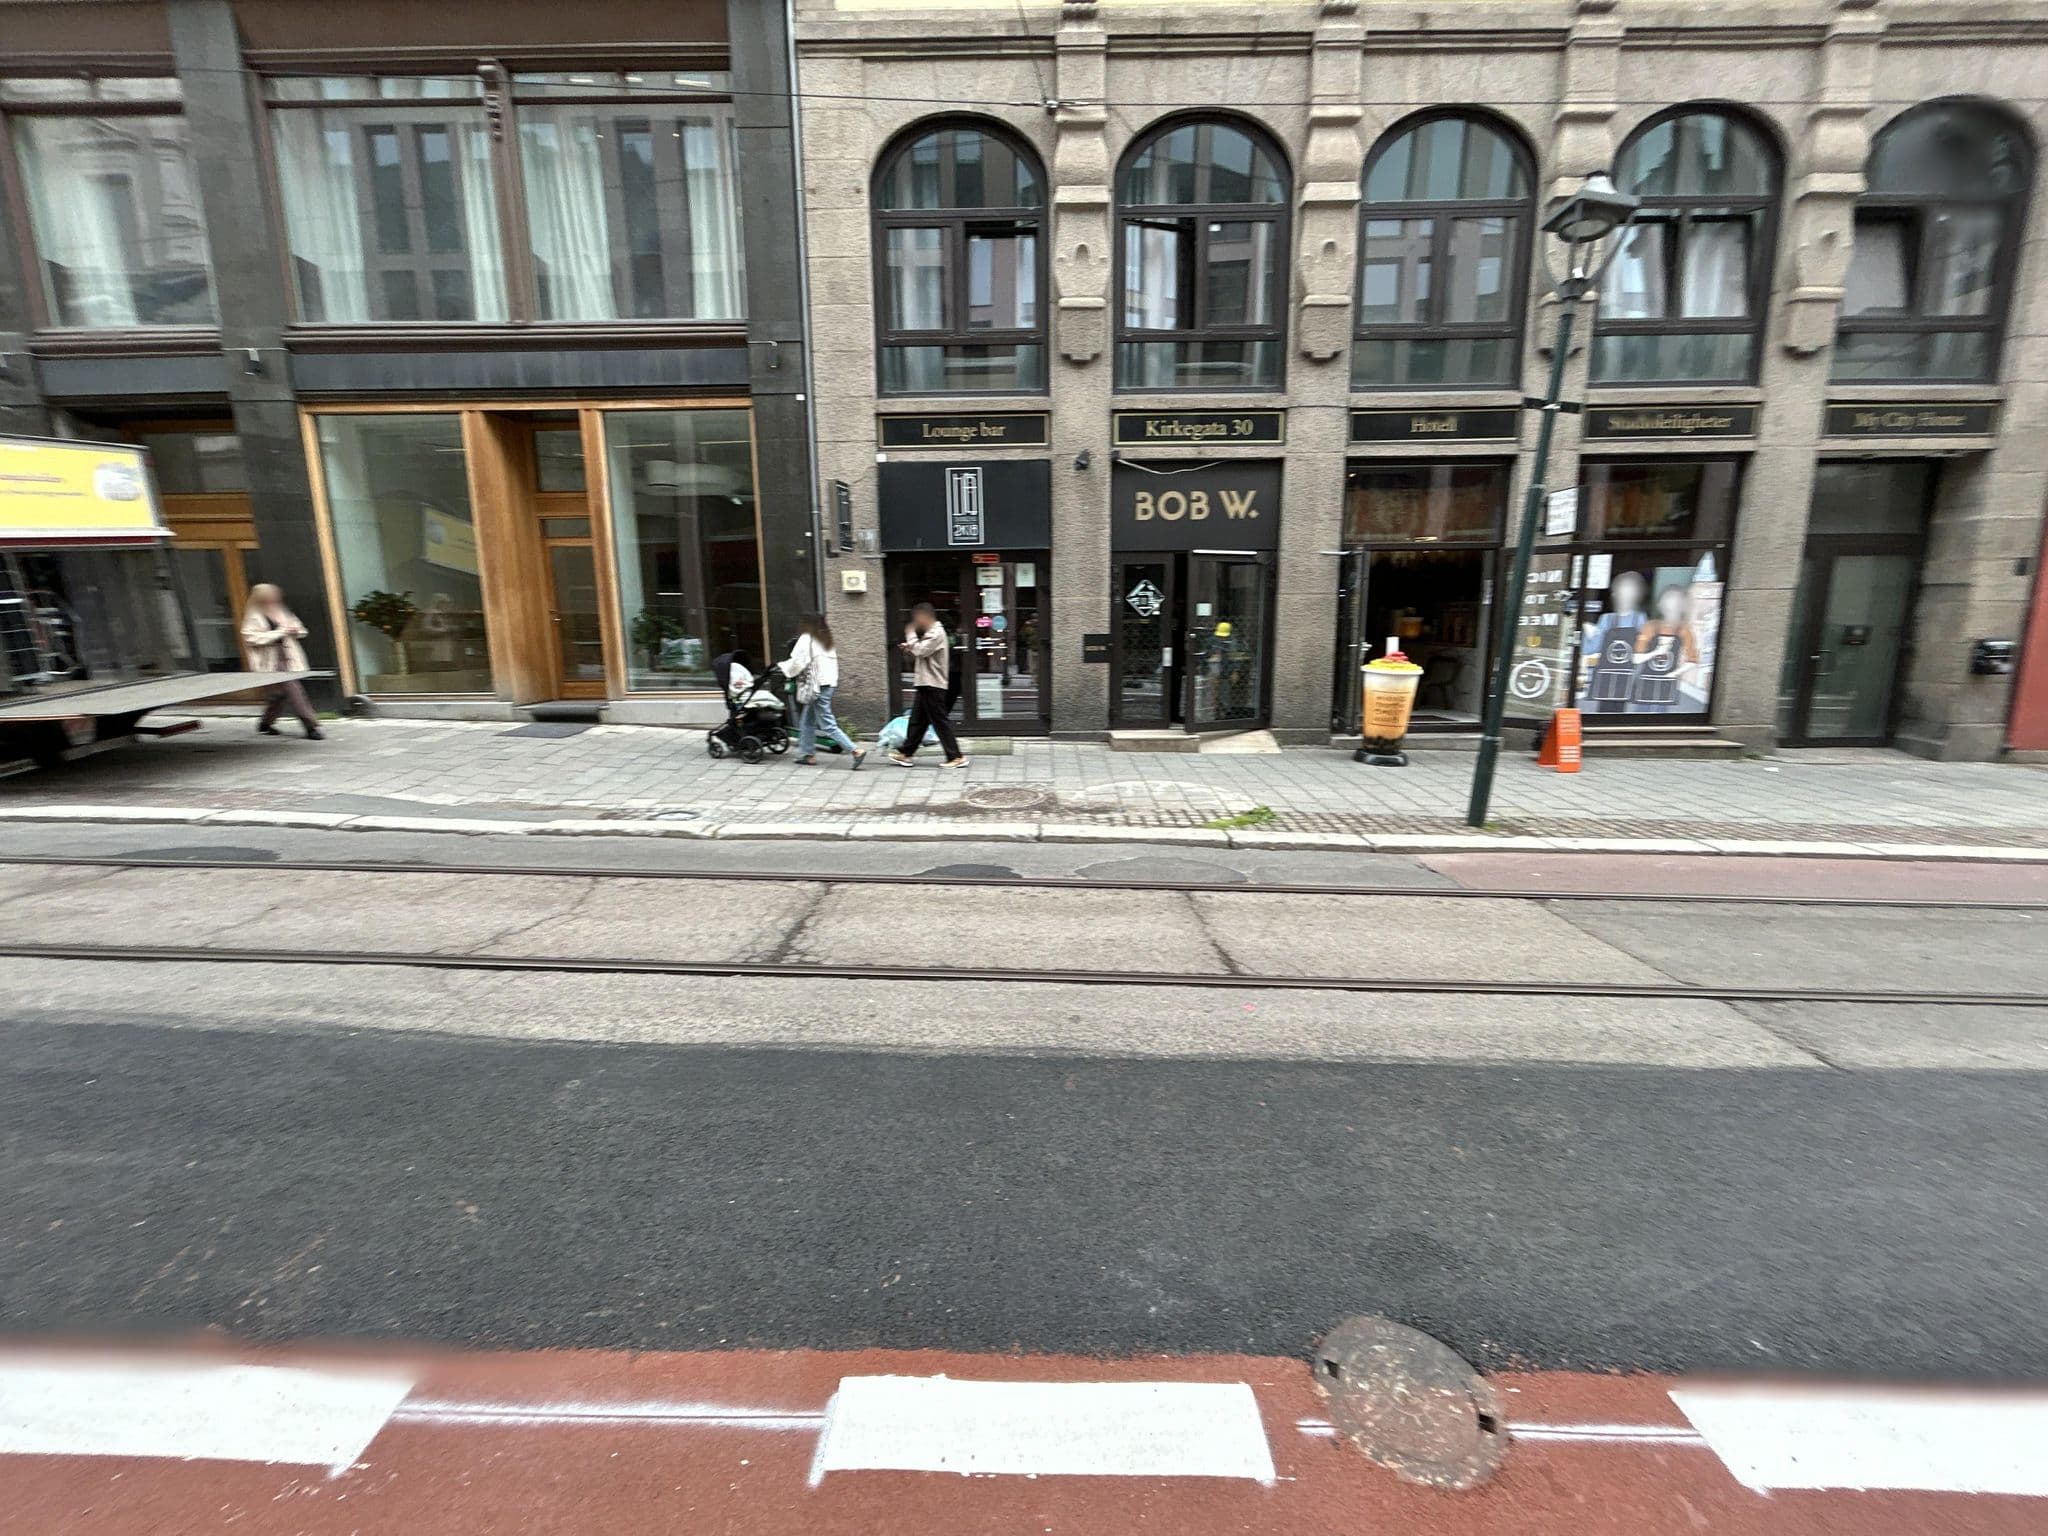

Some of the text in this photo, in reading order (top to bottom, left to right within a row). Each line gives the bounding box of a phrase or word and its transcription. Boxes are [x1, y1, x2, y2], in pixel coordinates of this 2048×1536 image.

[922, 421, 1007, 442] Lounge bar
[1145, 418, 1254, 440] Kirkegata 30
[1135, 490, 1260, 521] BOB W.
